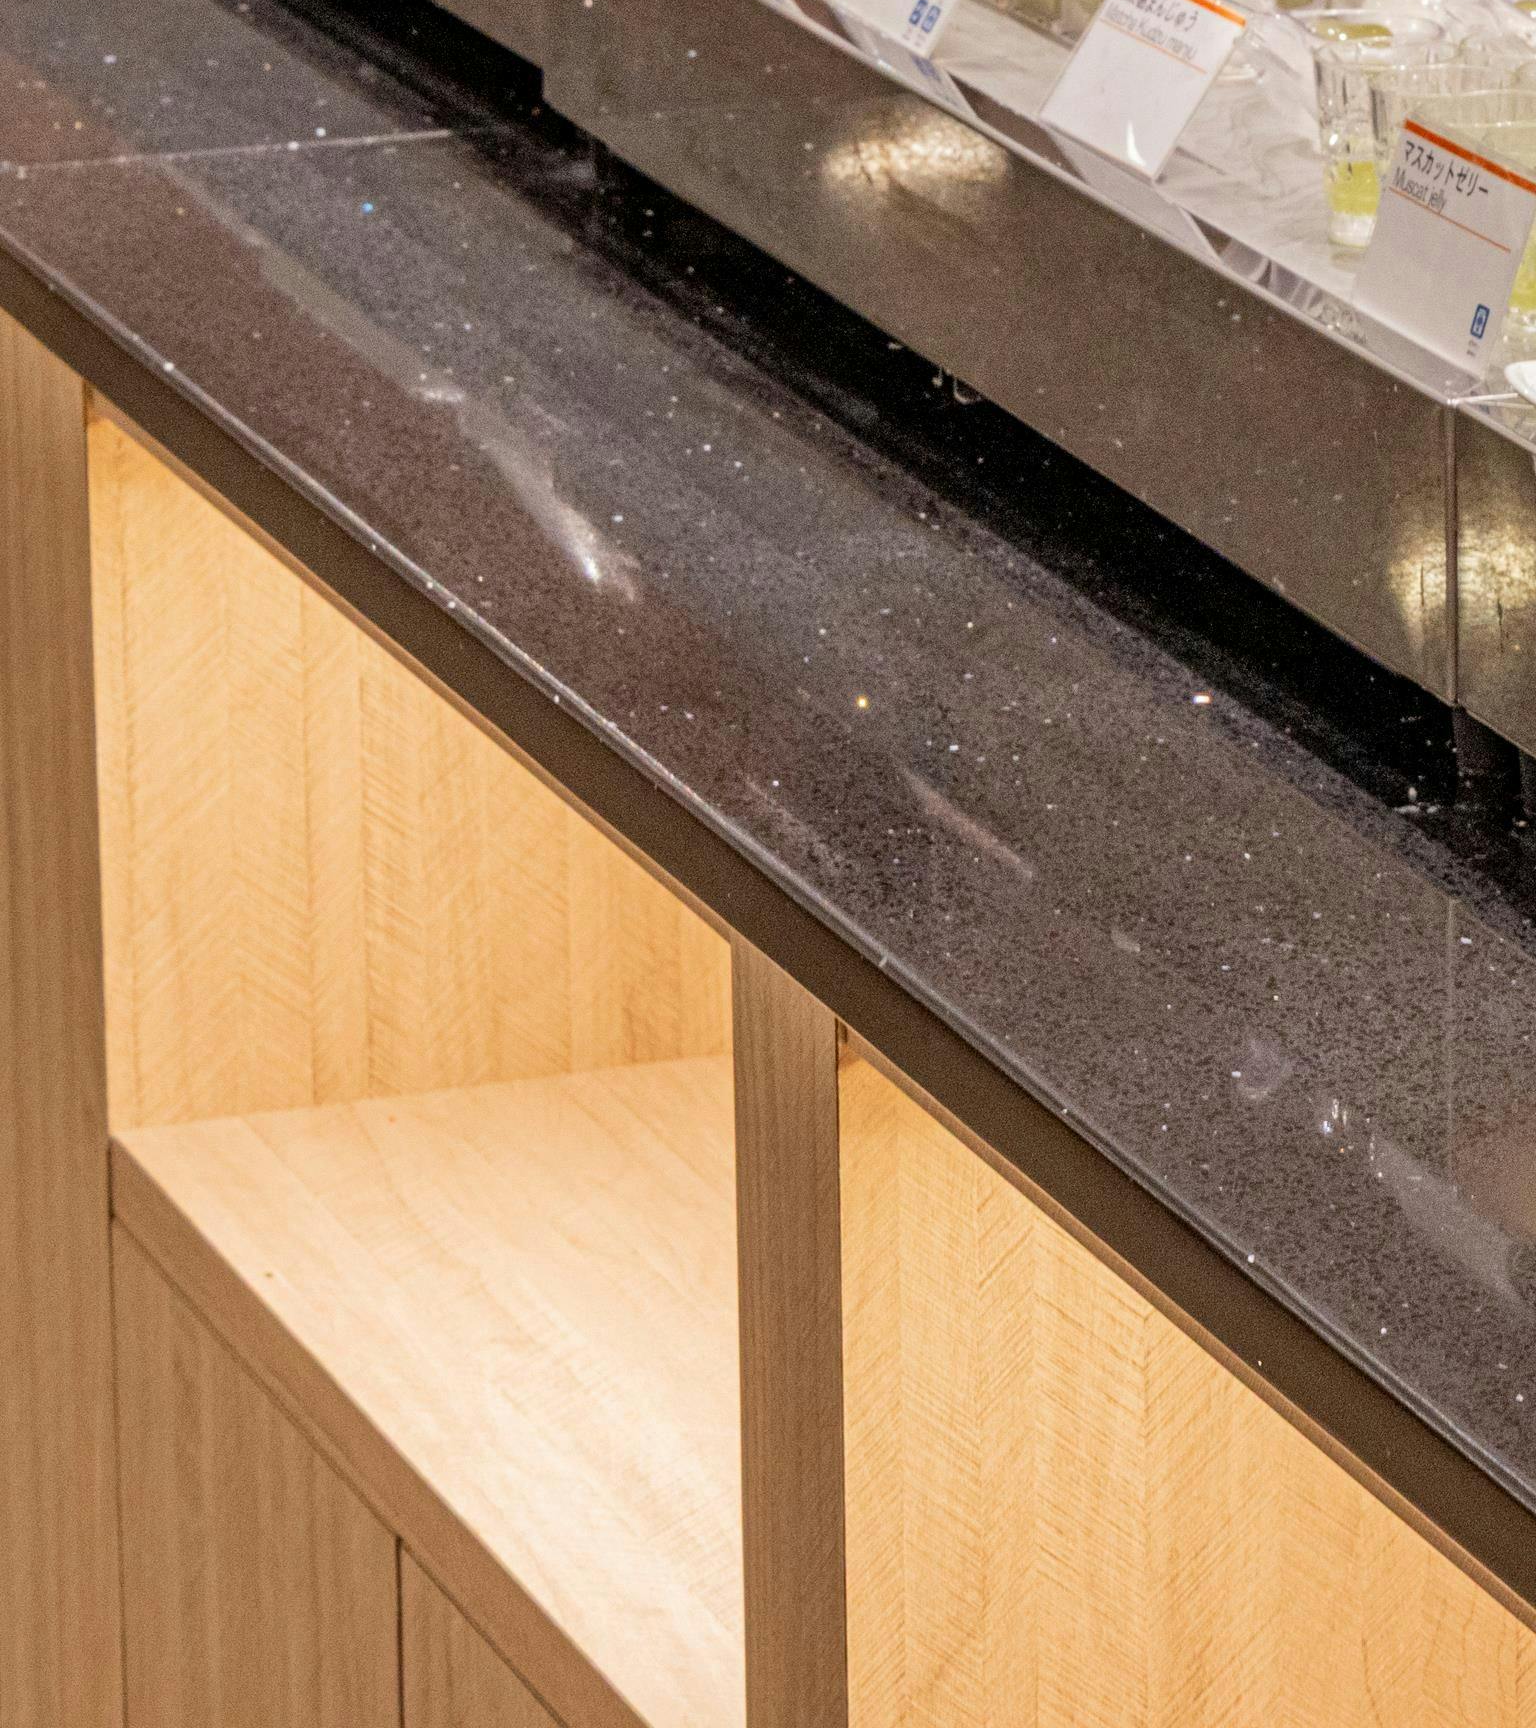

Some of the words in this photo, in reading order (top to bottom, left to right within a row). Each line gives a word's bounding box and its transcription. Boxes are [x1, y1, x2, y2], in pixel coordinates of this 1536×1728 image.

[1393, 166, 1429, 202] Muscat
[1428, 185, 1447, 212] jelly
[1405, 140, 1489, 197] マスカットゼリー
